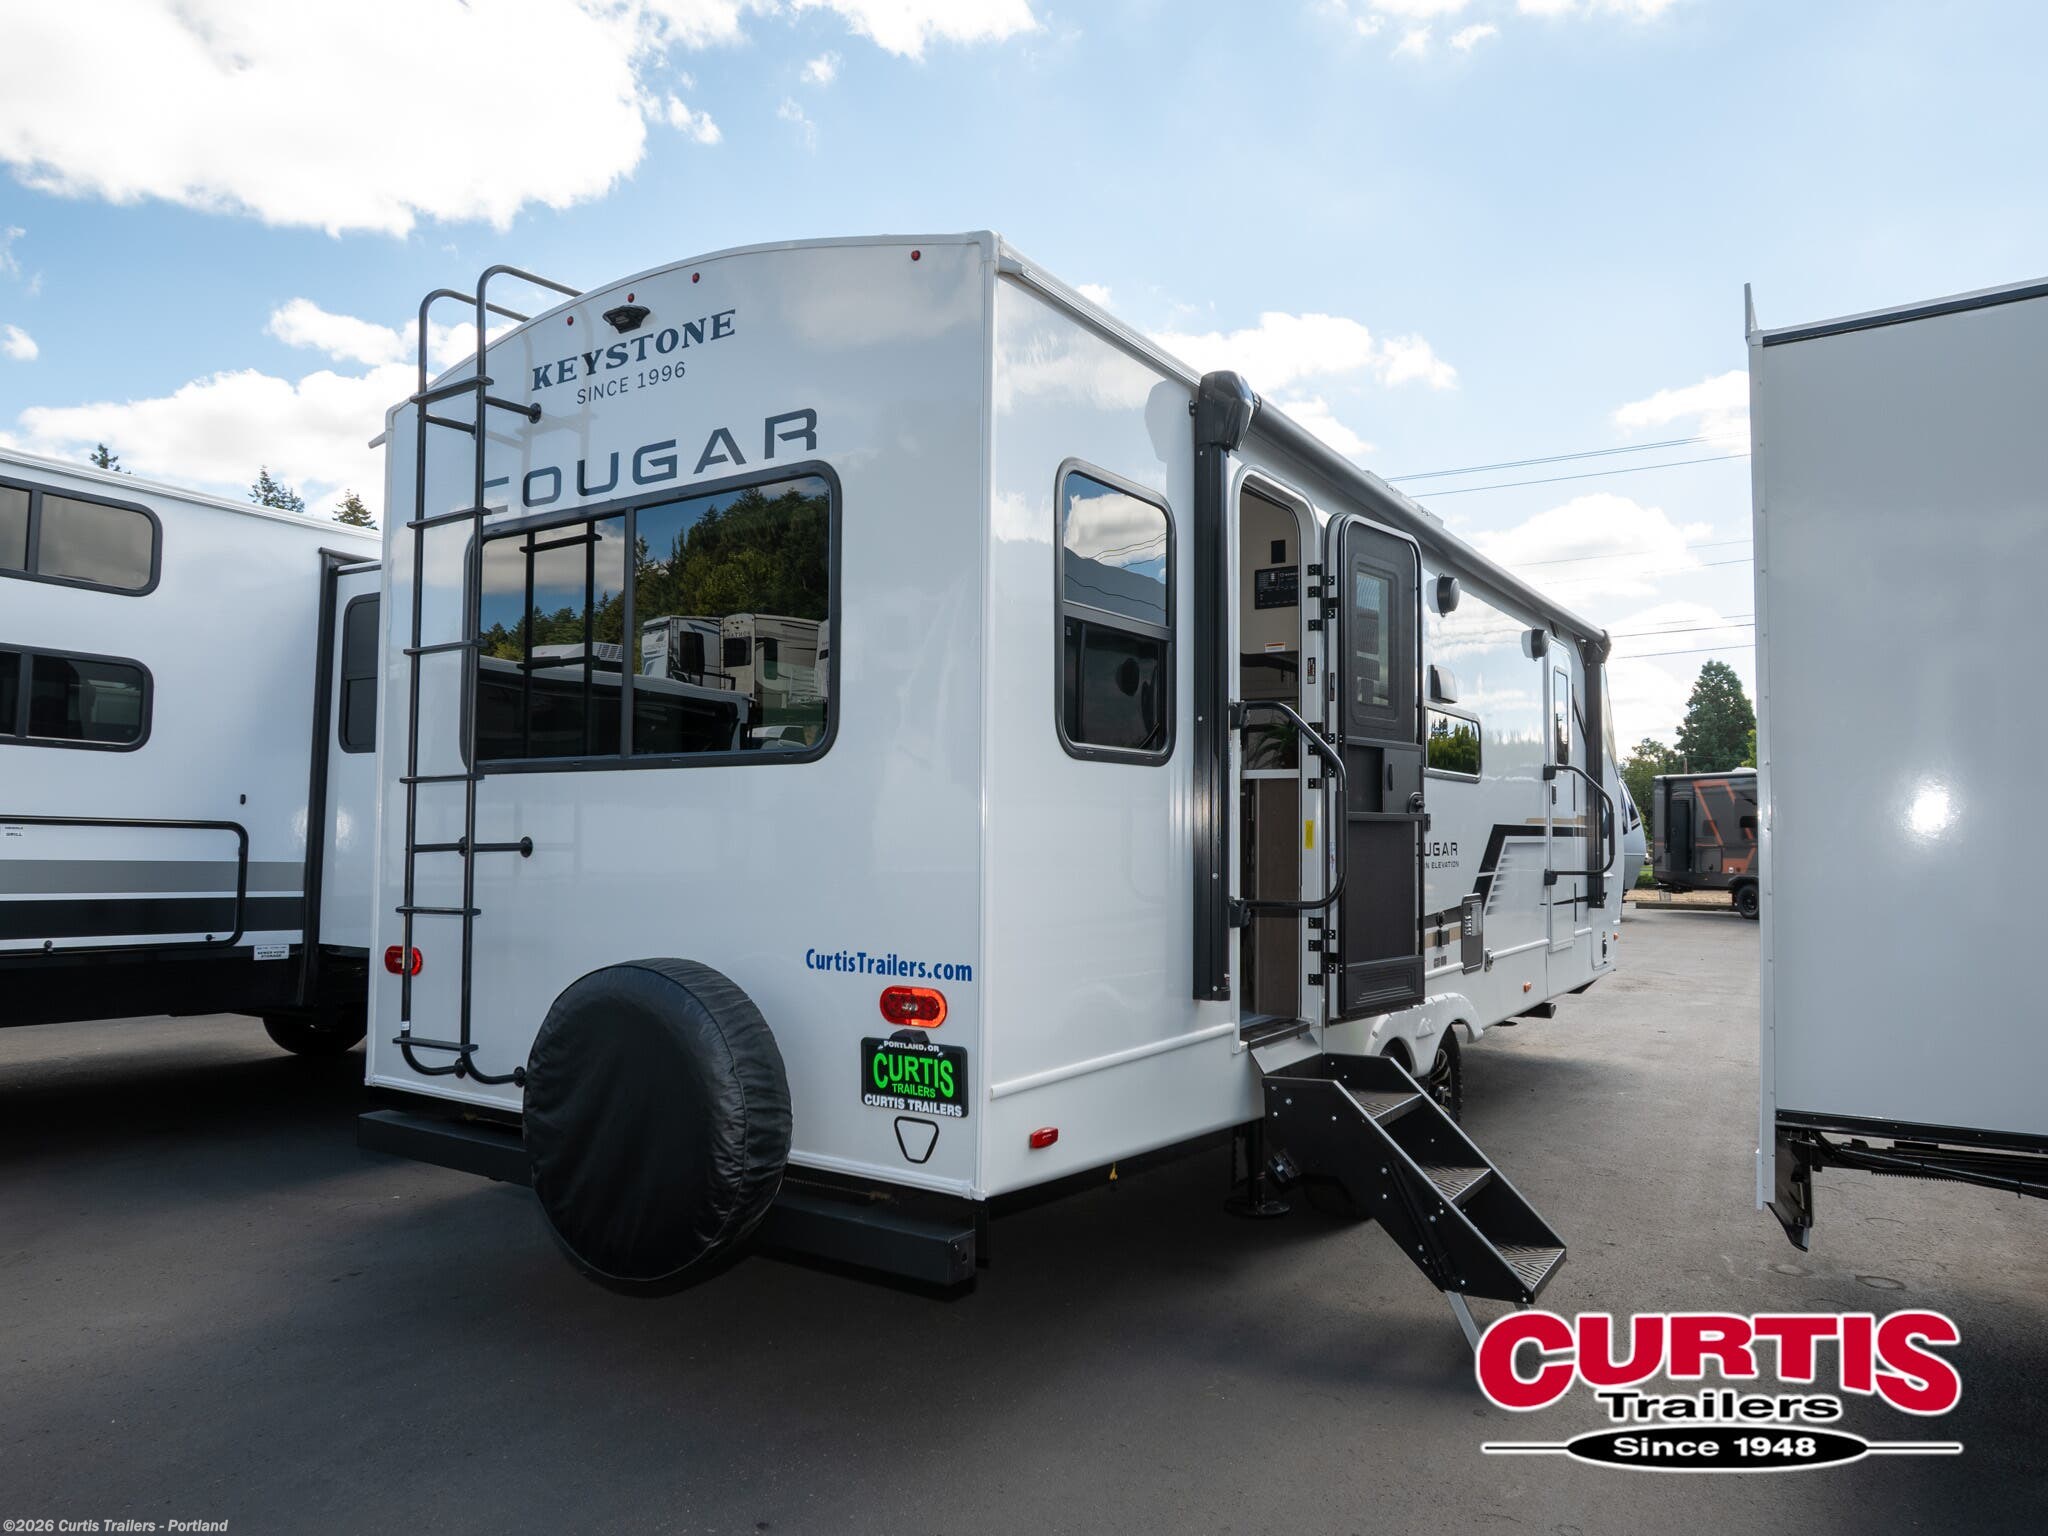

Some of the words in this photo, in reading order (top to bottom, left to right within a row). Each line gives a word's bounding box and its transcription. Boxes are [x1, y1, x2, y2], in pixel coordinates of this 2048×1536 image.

[532, 309, 736, 391] KEYSTONE
[577, 376, 629, 404] SINCE
[637, 361, 685, 389] 1996
[1416, 842, 1458, 857] UGAR
[806, 949, 972, 981] CurtisTrailers.com
[928, 1044, 940, 1053] OR
[873, 1052, 954, 1098] CURTIS
[892, 1083, 936, 1098] TRAILERS
[864, 1093, 905, 1110] CURTIS
[908, 1099, 962, 1118] TRAILERS
